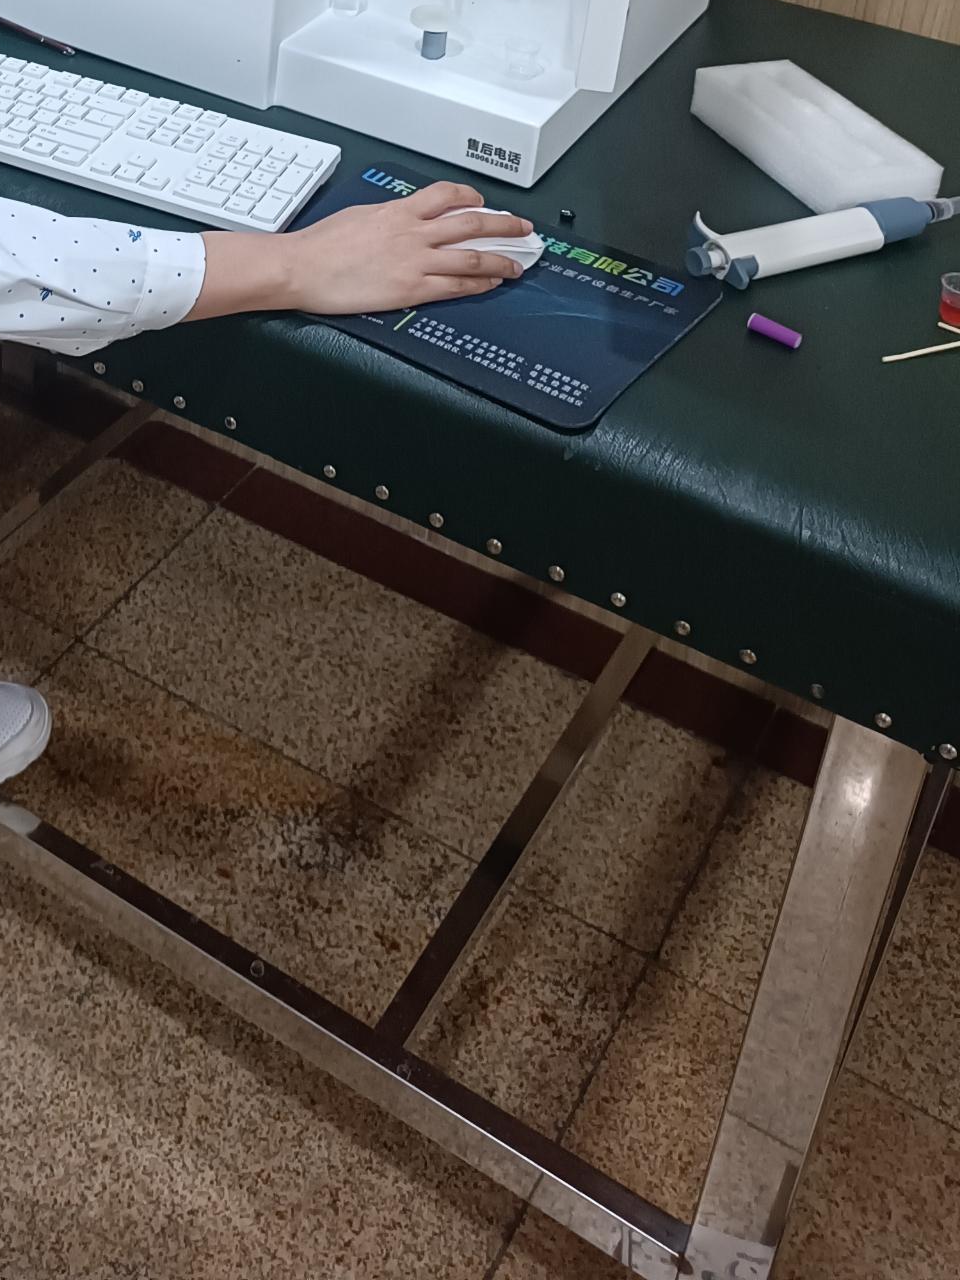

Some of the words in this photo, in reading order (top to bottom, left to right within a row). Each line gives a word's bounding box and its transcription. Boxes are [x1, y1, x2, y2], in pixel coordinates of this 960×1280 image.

[467, 137, 522, 166] 售后电话
[361, 168, 417, 196] 山东
[538, 233, 685, 297] 技有限公司
